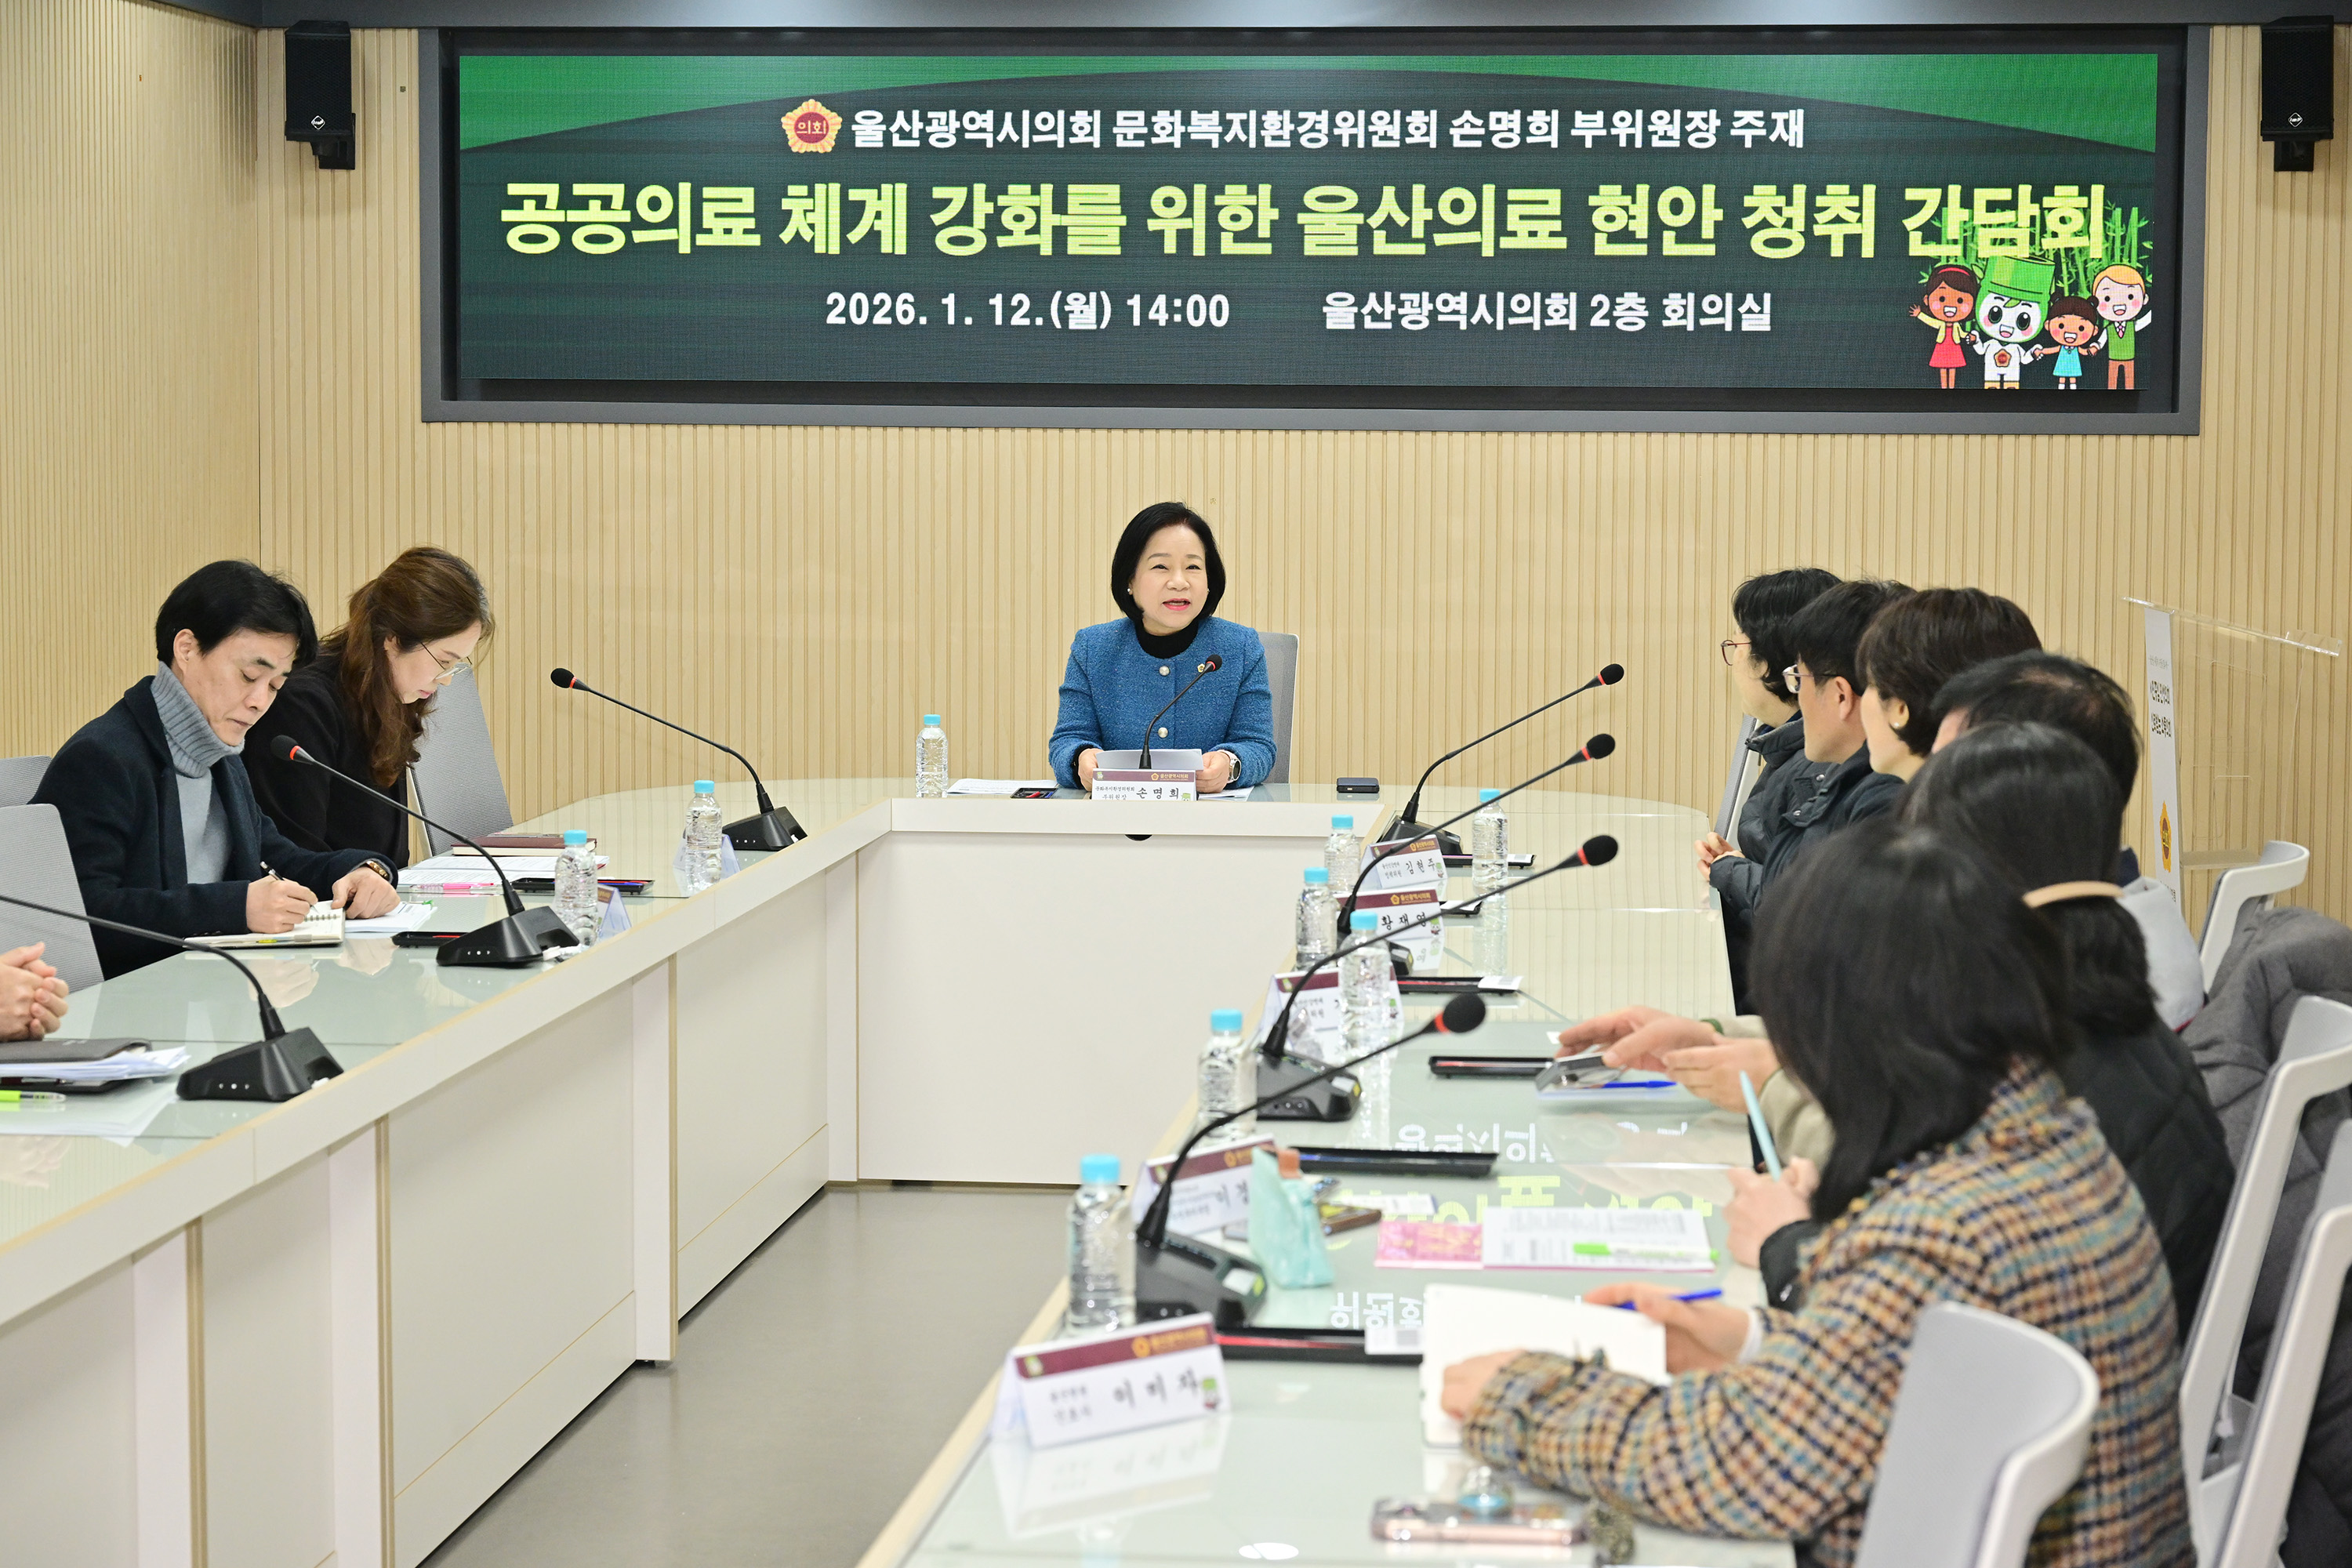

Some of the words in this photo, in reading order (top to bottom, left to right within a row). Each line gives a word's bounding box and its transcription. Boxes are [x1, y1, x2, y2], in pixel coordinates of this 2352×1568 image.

[796, 120, 827, 135] 의회
[851, 108, 1101, 149] 울산광역시의회
[1112, 109, 1438, 149] 문화복지환경위원회
[1449, 109, 1560, 149] 손명희
[1570, 109, 1722, 149] 부위원장
[1730, 108, 1806, 149] 주재
[501, 182, 762, 256] 공공의료
[779, 183, 909, 256] 체계
[931, 183, 1127, 257] 강화를
[1147, 183, 1281, 257] 위한
[1297, 184, 1569, 258] 울산의료
[1588, 184, 1724, 258] 현안
[1742, 184, 1878, 260] 청취
[1903, 184, 2106, 260] 간담회
[826, 292, 927, 326] 2026.
[941, 292, 974, 326] 1.
[989, 290, 1112, 331] 12.(월)
[1127, 293, 1230, 327] 14:00
[1322, 291, 1578, 332] 울산광역시의회
[1589, 292, 1650, 332] 2층
[1661, 292, 1772, 332] 회의실
